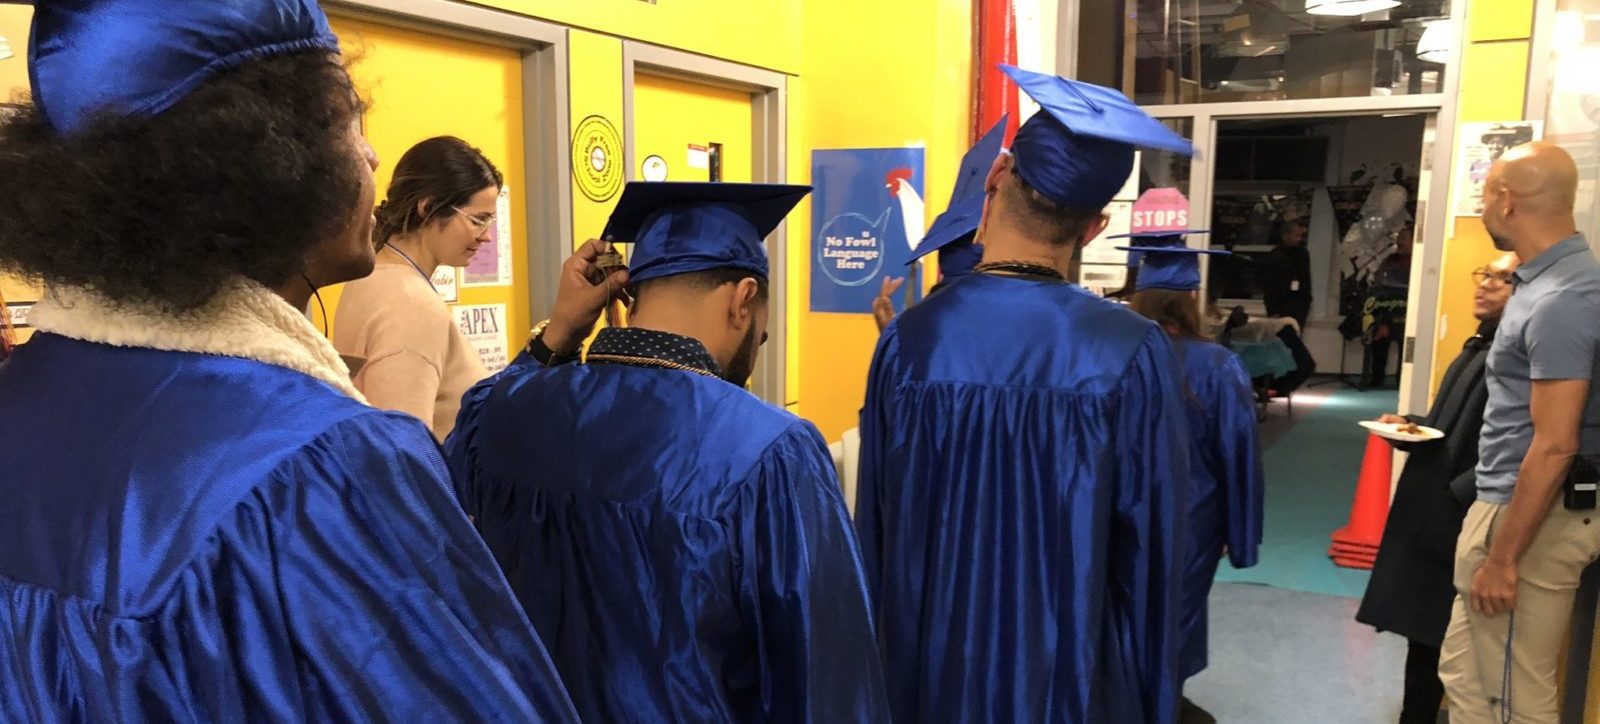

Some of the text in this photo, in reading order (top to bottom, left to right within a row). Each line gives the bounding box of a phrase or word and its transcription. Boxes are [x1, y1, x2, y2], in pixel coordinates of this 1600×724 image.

[1133, 209, 1188, 227] STOPS
[826, 236, 877, 247] No Fowl
[823, 247, 879, 261] Language
[836, 258, 865, 269] Here
[464, 307, 499, 335] APEX
